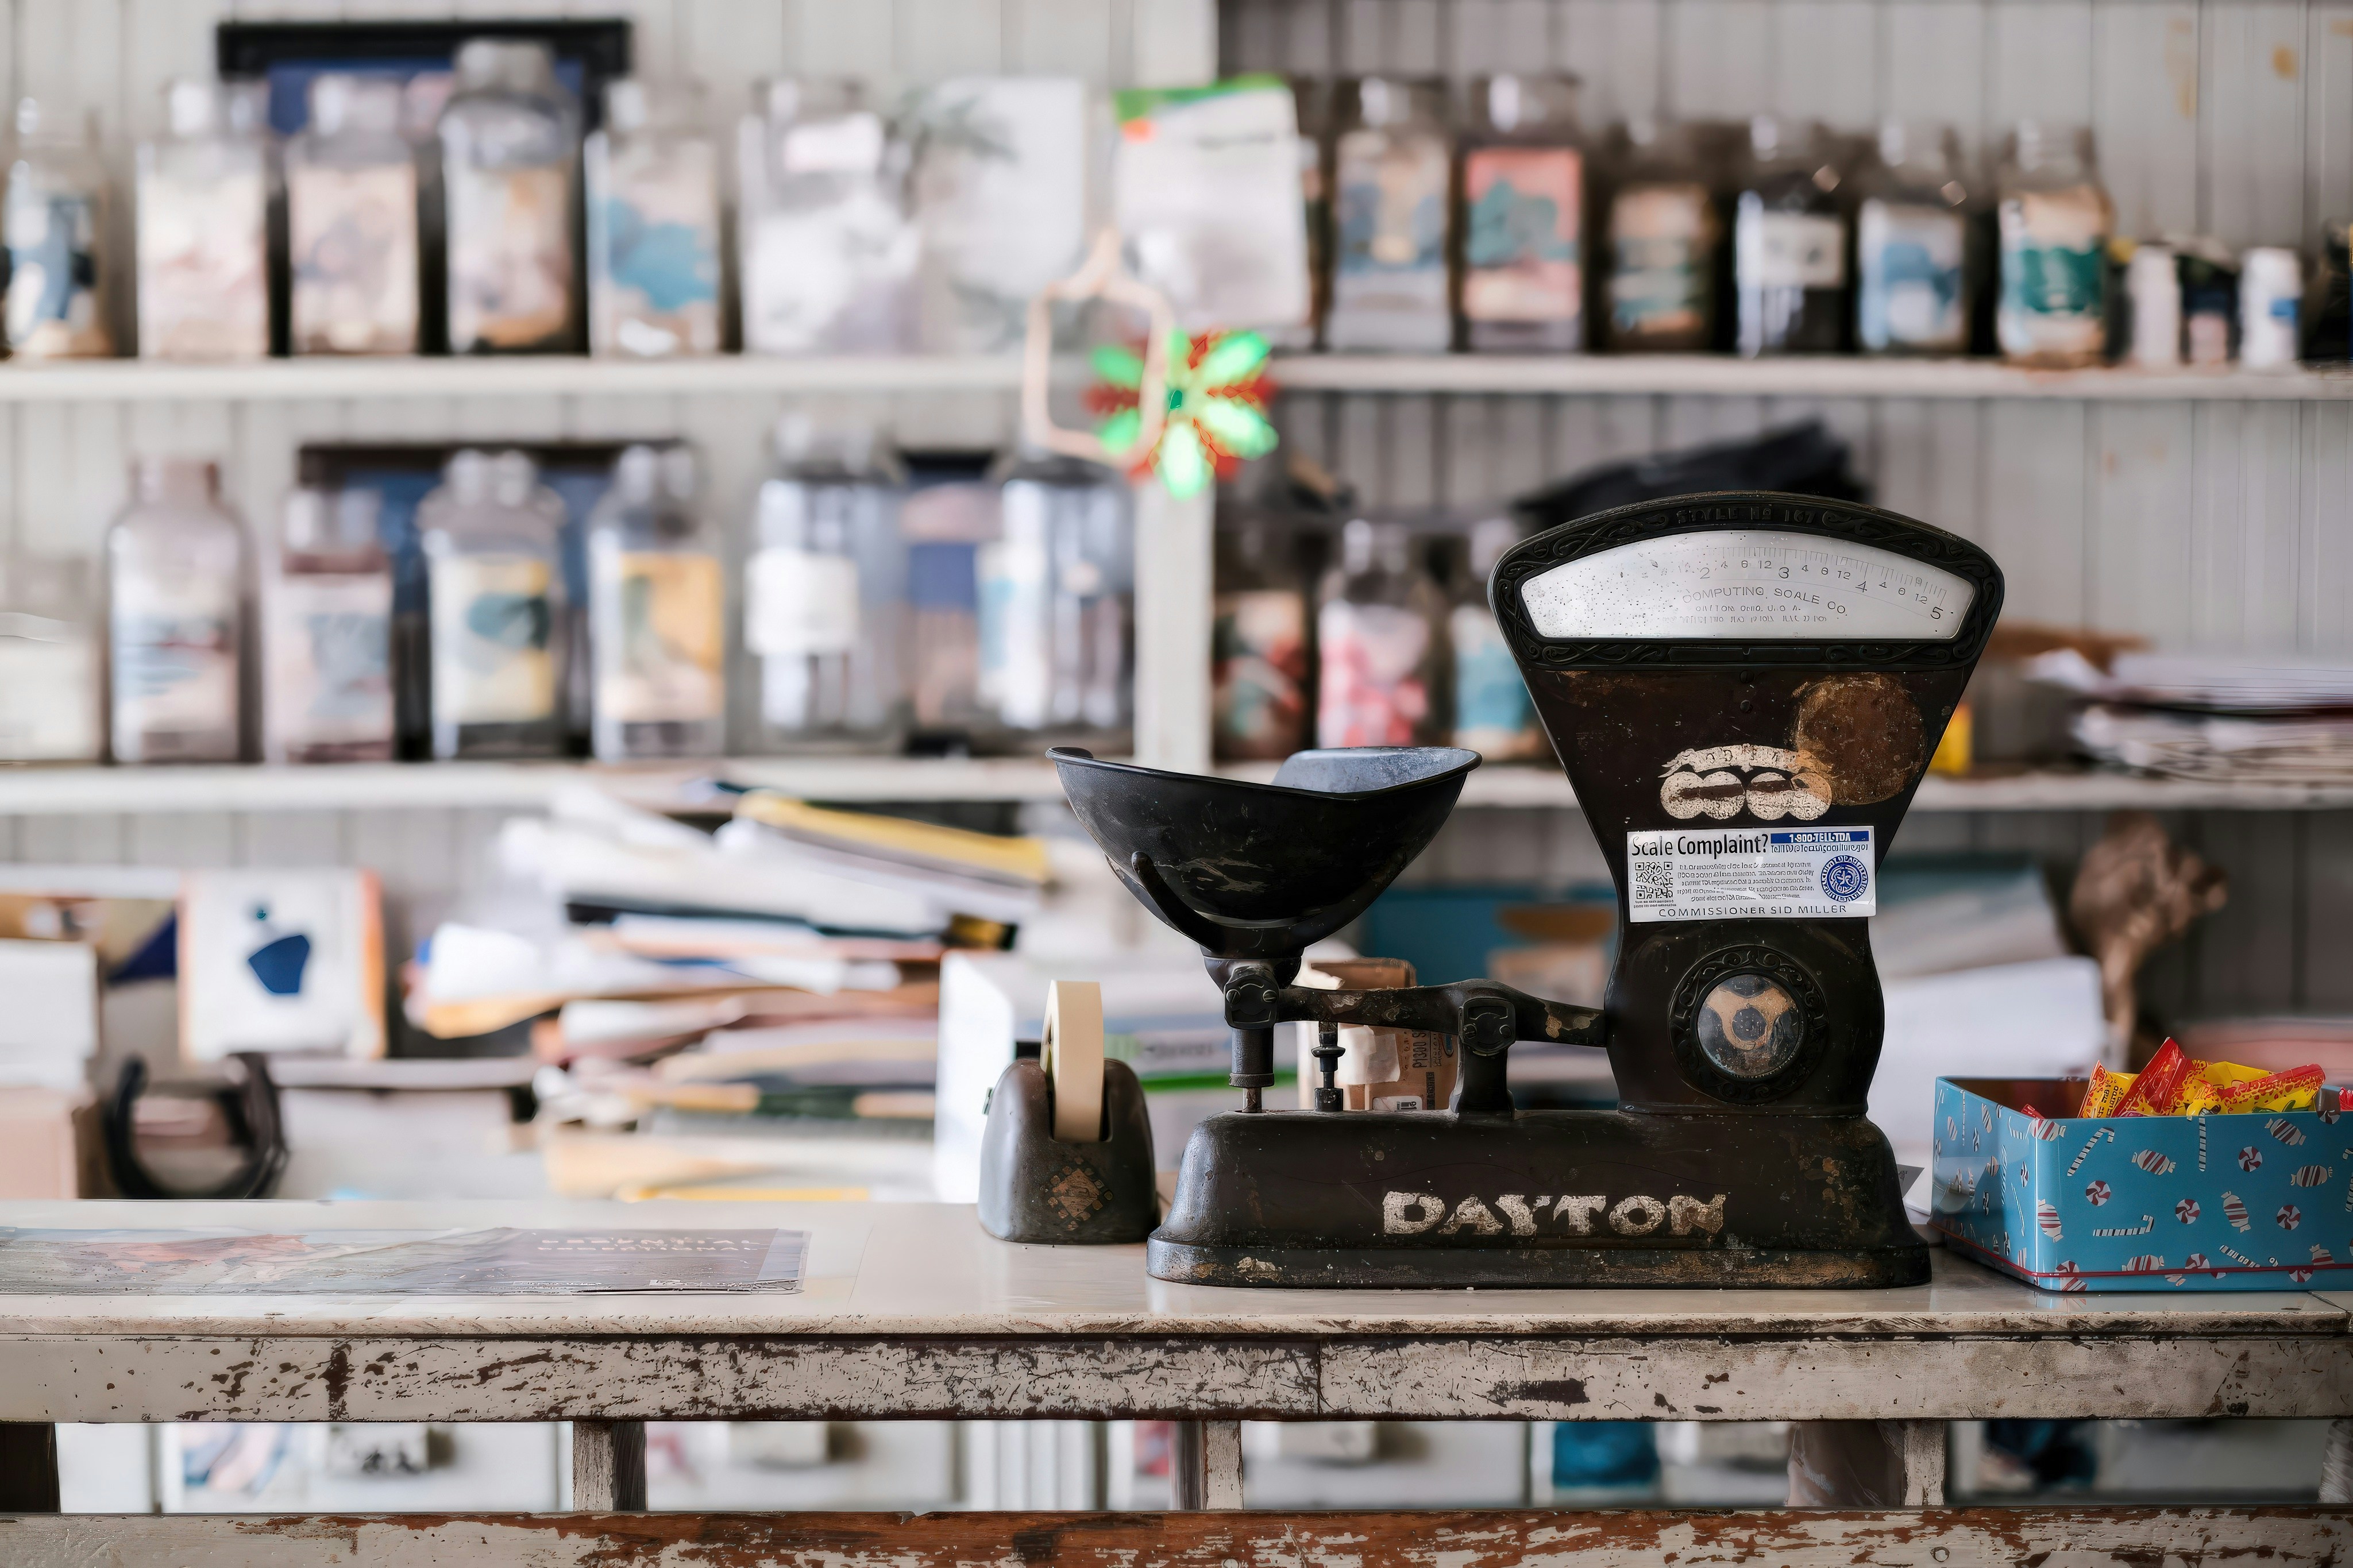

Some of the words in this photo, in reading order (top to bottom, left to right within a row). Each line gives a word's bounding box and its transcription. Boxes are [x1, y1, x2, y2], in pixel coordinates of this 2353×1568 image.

[1758, 560, 1772, 569] 12
[1778, 566, 1789, 579] 3
[1838, 570, 1851, 580] 12
[1855, 581, 1868, 593] 4
[1930, 606, 1944, 620] 5
[1631, 836, 1673, 856] Scale
[1677, 834, 1769, 860] Complaint?
[1658, 907, 1765, 917] COMMISSIONER
[1770, 906, 1792, 914] SID
[1797, 905, 1847, 914] MILLER
[1382, 1190, 1727, 1238] DAYTON
